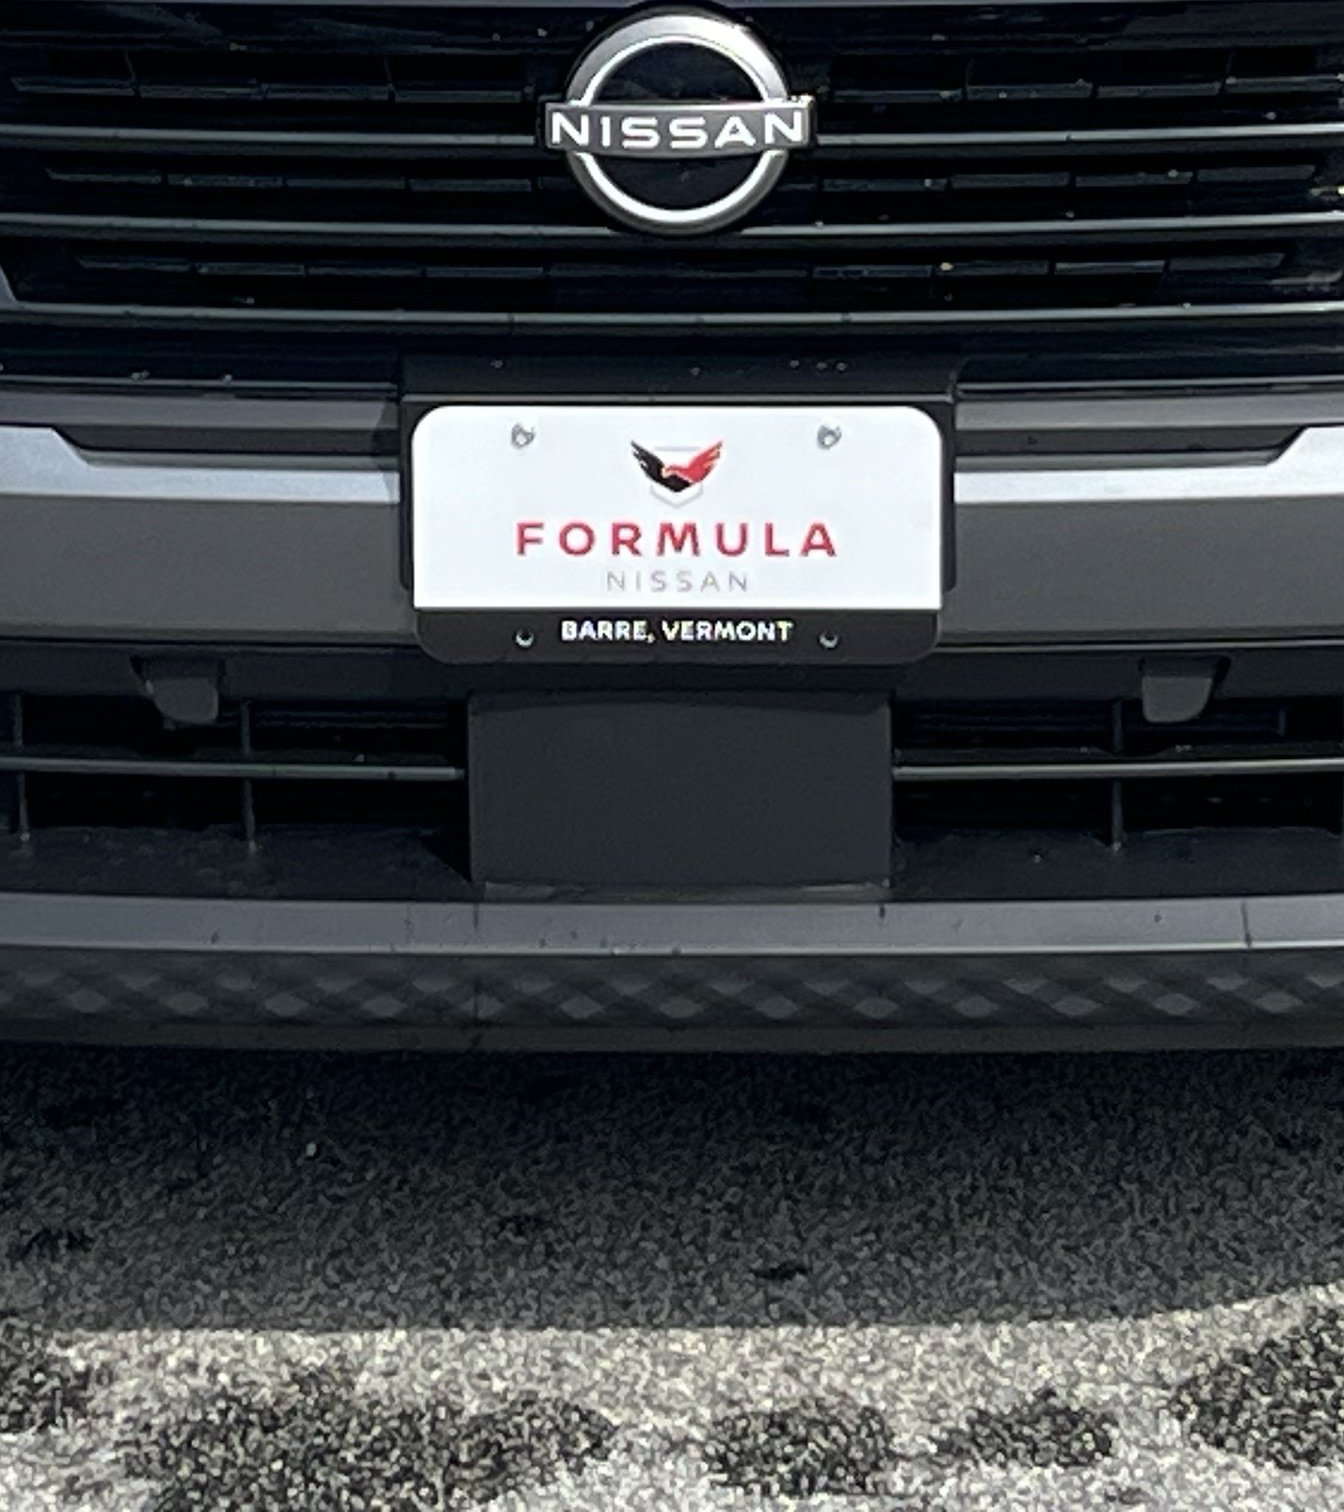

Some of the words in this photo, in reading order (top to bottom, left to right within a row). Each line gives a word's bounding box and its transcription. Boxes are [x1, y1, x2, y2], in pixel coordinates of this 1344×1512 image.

[551, 110, 803, 149] NISSAN
[515, 522, 838, 557] FORMULA
[606, 570, 750, 593] NISSAN
[560, 620, 656, 644] BARRE,
[661, 620, 795, 642] VERMONT
